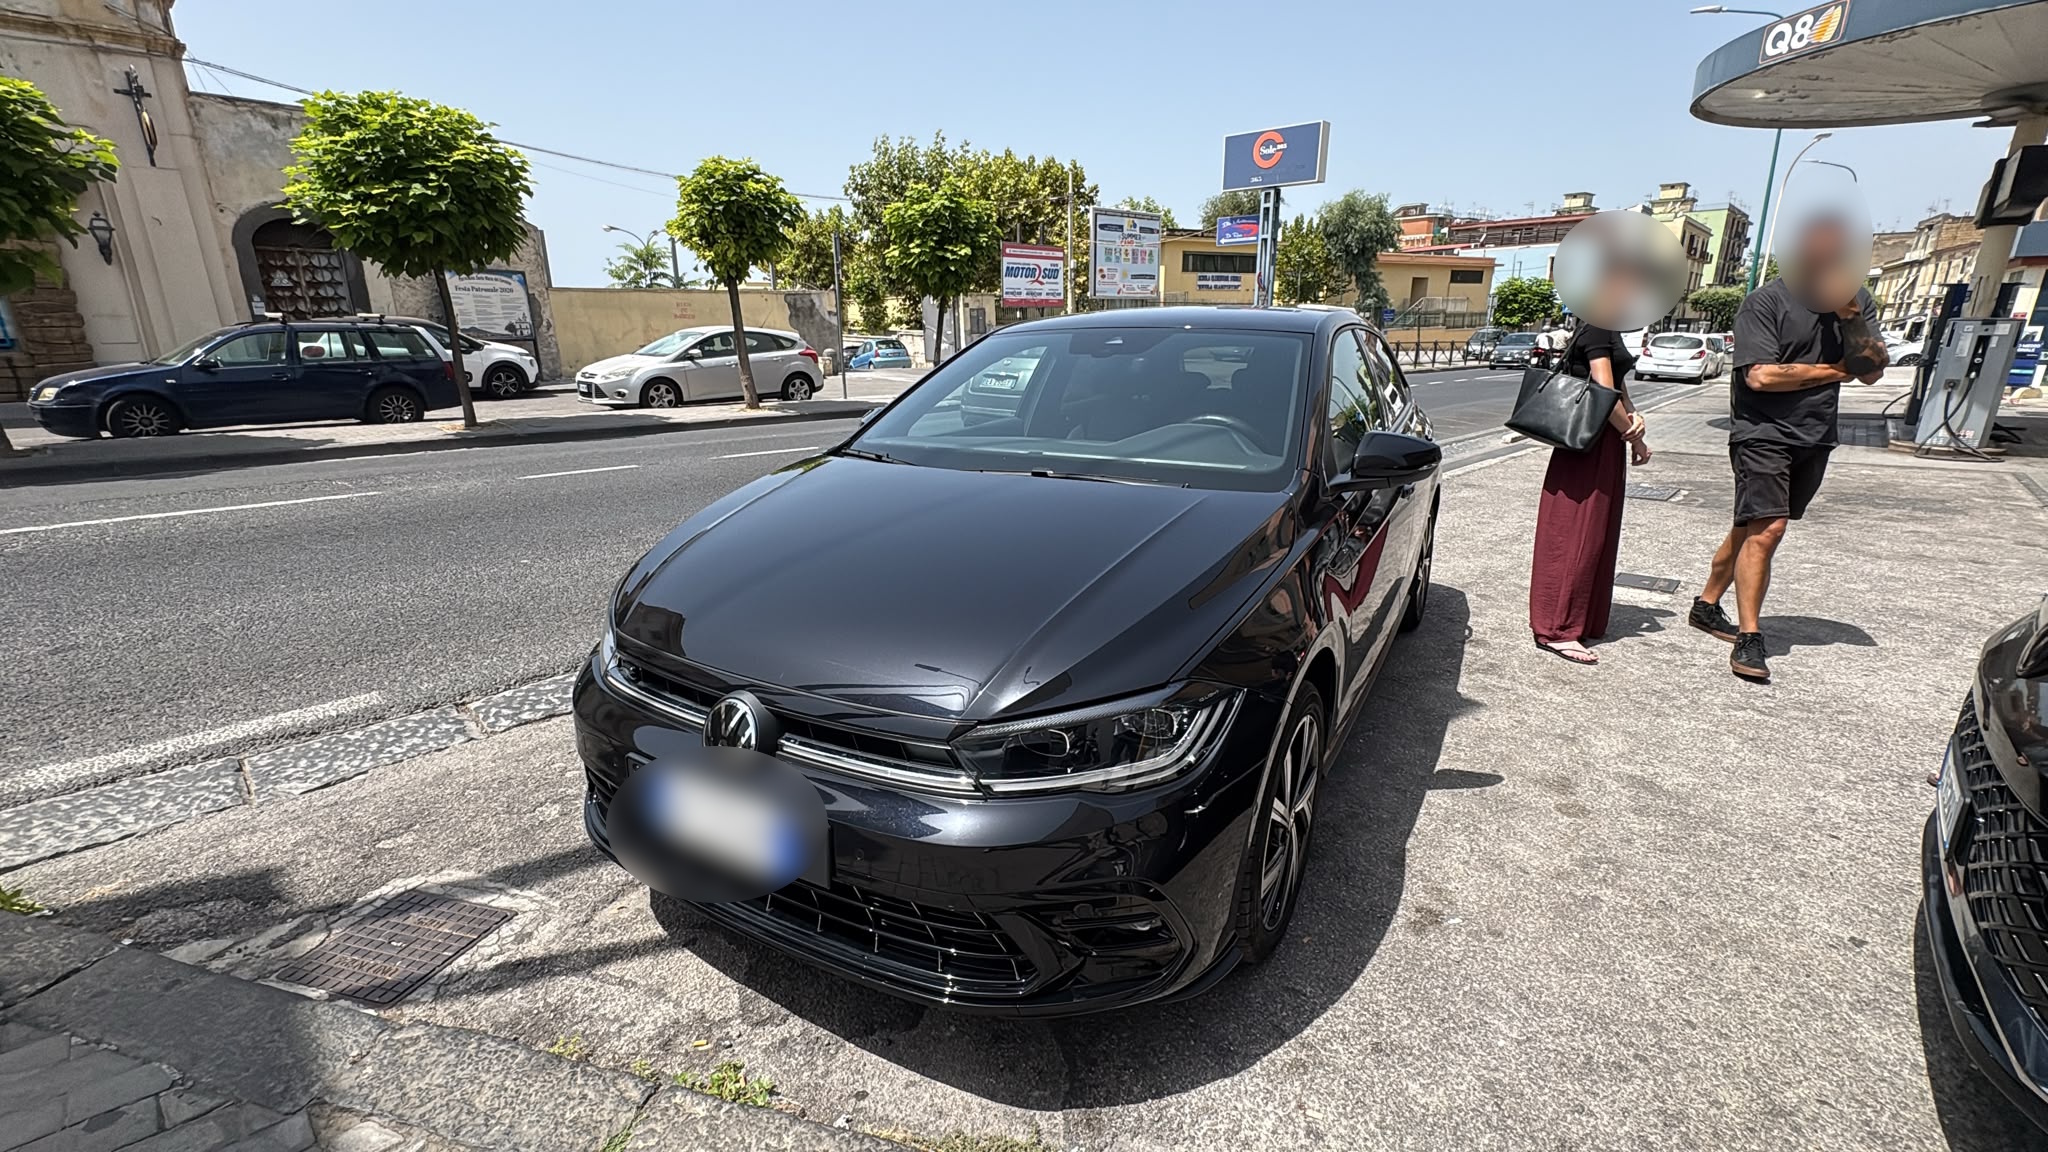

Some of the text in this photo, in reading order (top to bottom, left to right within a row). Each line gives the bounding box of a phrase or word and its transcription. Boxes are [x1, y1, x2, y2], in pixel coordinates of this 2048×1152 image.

[1765, 14, 1814, 56] Q8
[1005, 266, 1037, 278] MOTOR
[1042, 267, 1060, 279] SUD
